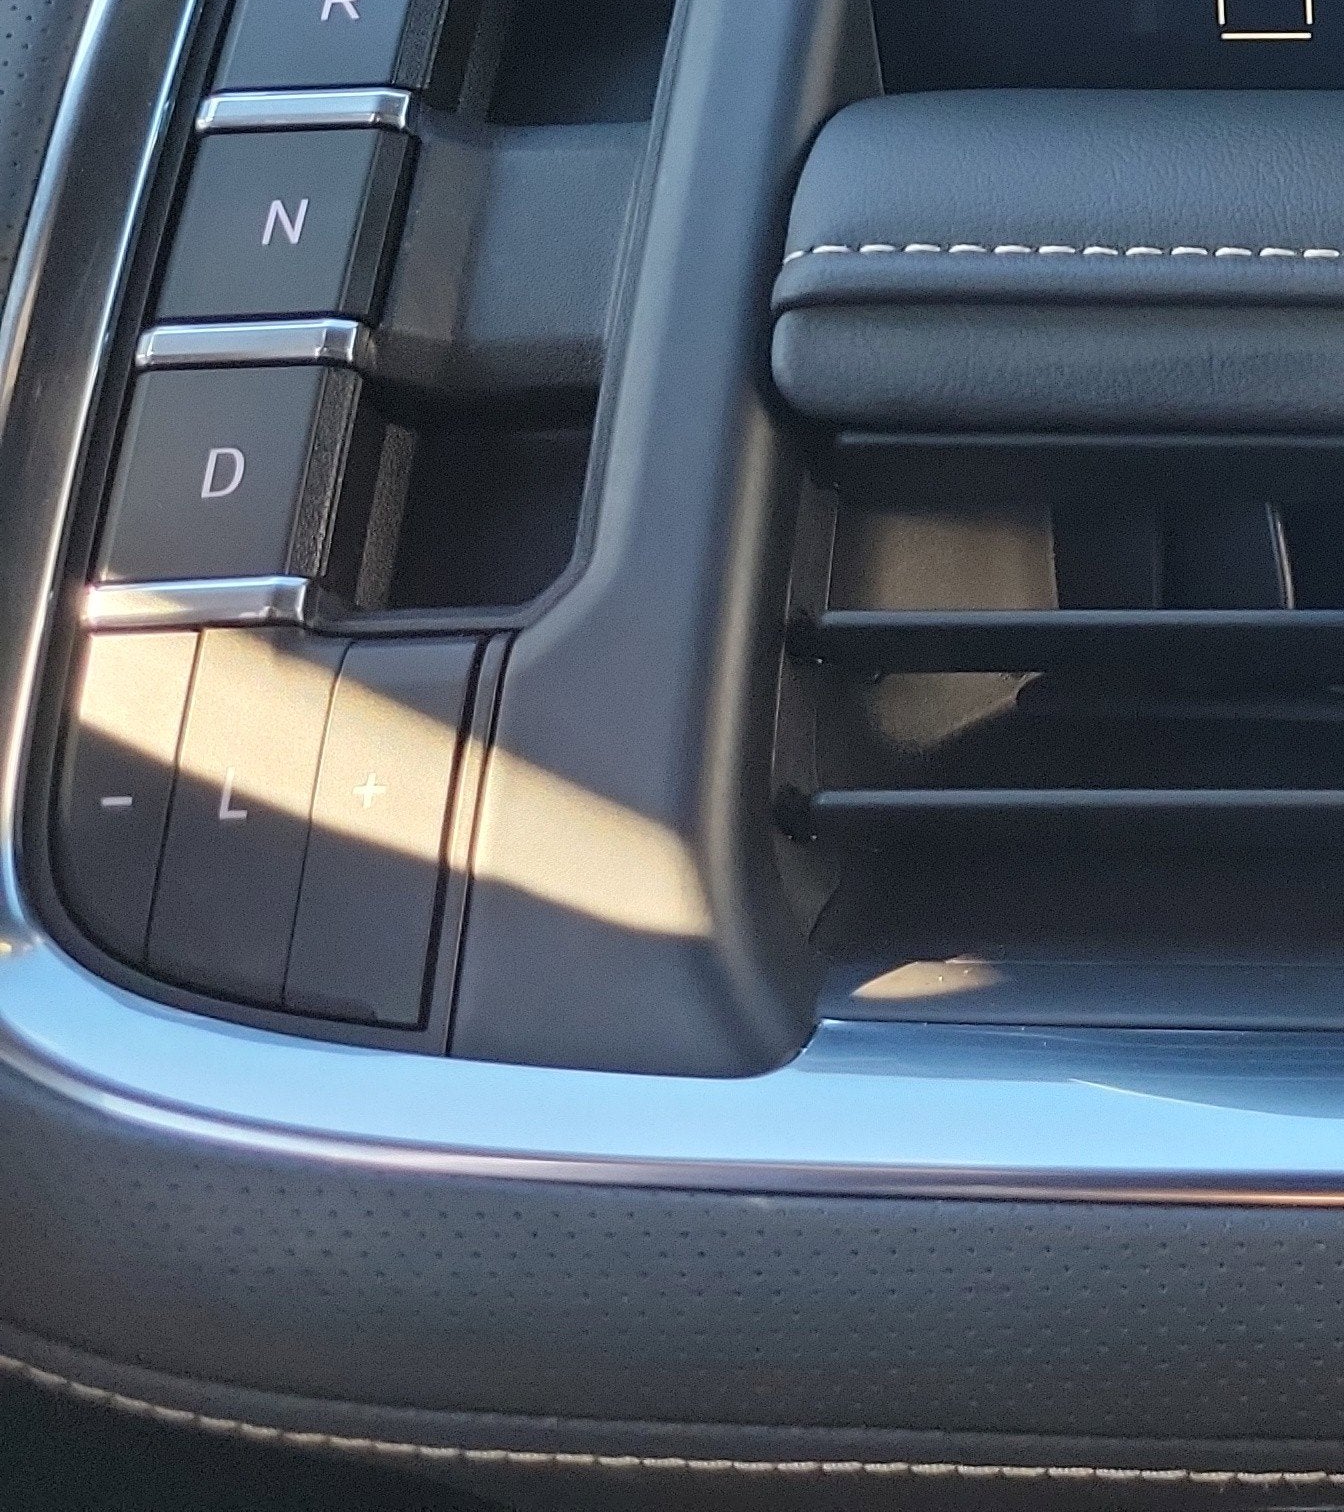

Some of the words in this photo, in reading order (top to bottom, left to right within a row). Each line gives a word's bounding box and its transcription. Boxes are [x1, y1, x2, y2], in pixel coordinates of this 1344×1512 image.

[260, 198, 309, 246] N
[200, 446, 246, 498] D
[218, 766, 248, 821] L
